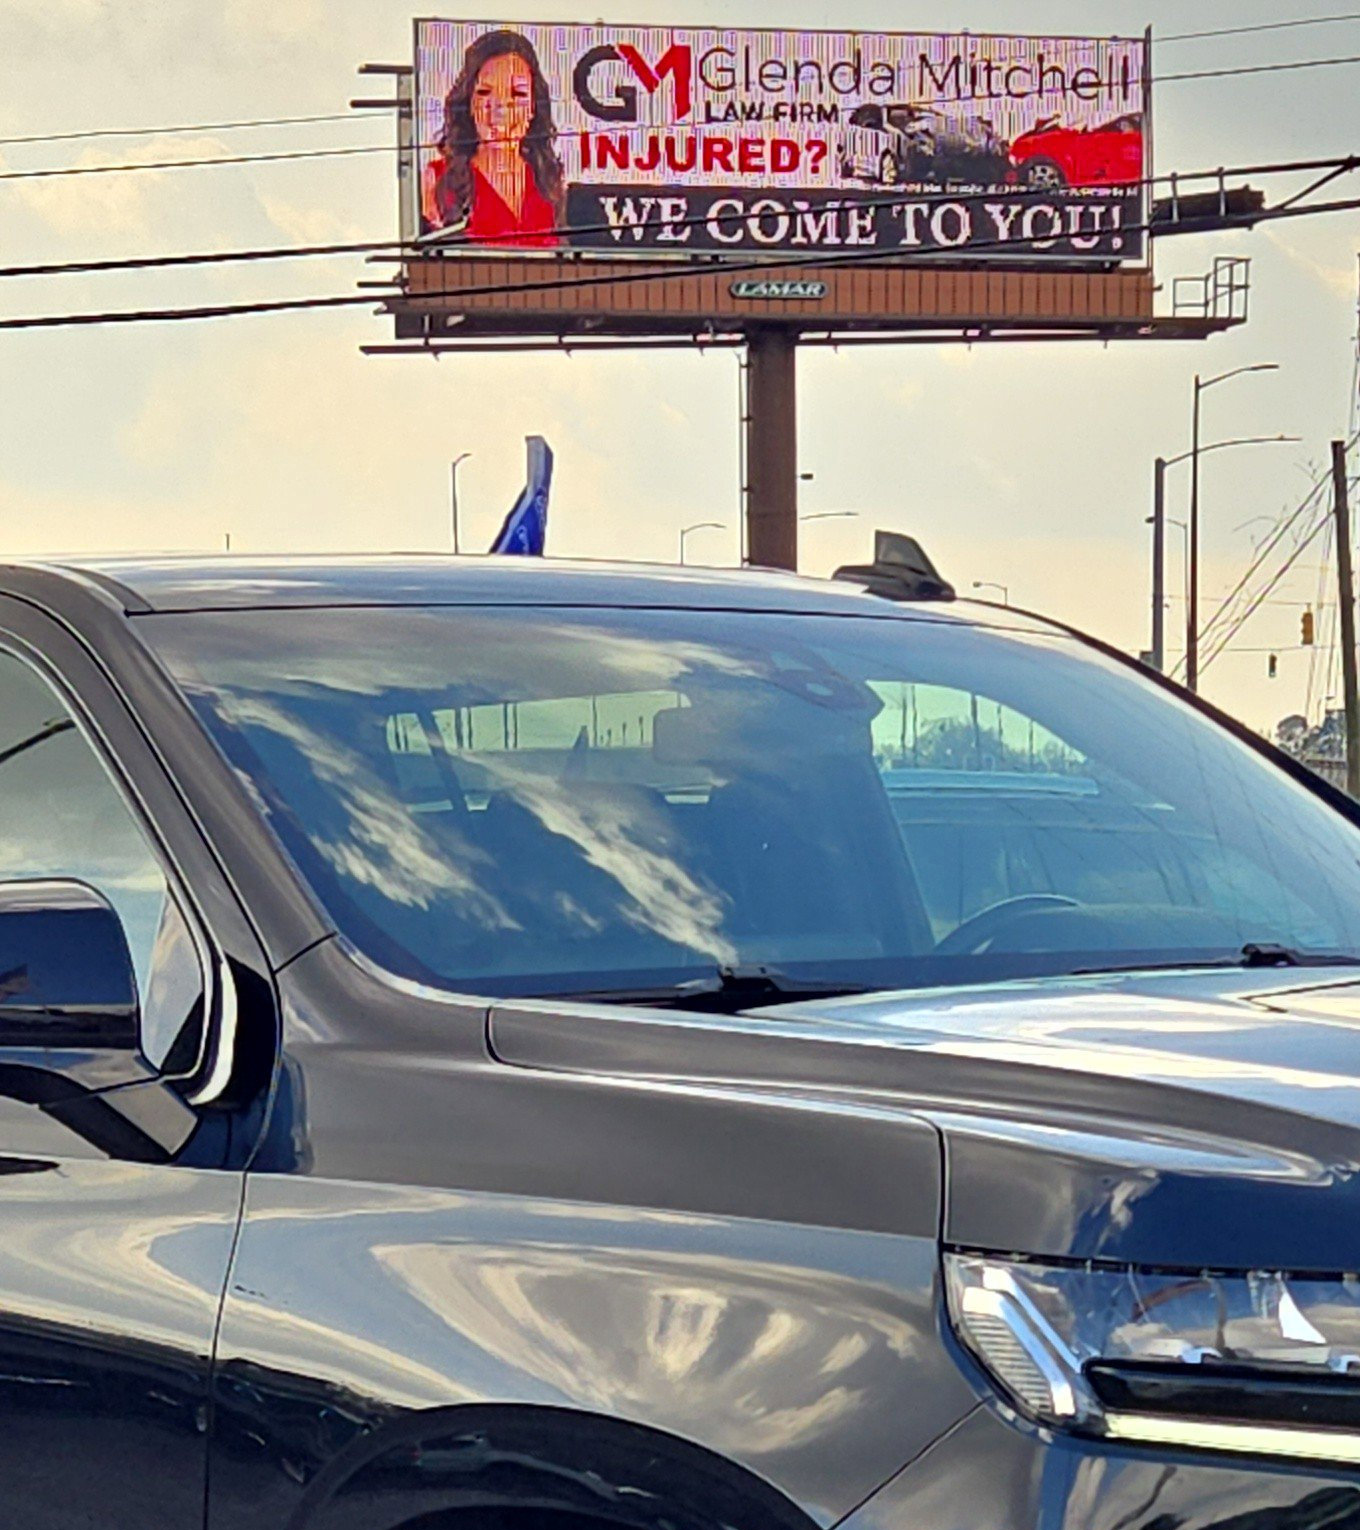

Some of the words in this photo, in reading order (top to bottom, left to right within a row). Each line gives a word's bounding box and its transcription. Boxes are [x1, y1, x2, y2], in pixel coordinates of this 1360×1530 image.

[573, 43, 691, 122] GM
[698, 45, 896, 96] Glenda
[918, 52, 1129, 101] Mitchell
[705, 100, 764, 123] LAW
[773, 102, 840, 123] FIRM
[579, 131, 828, 174] INJURED?
[598, 196, 692, 242] WE
[705, 198, 878, 245] COME
[892, 202, 972, 246] TO
[983, 203, 1124, 251] YOU!
[737, 282, 823, 297] LAMAR
